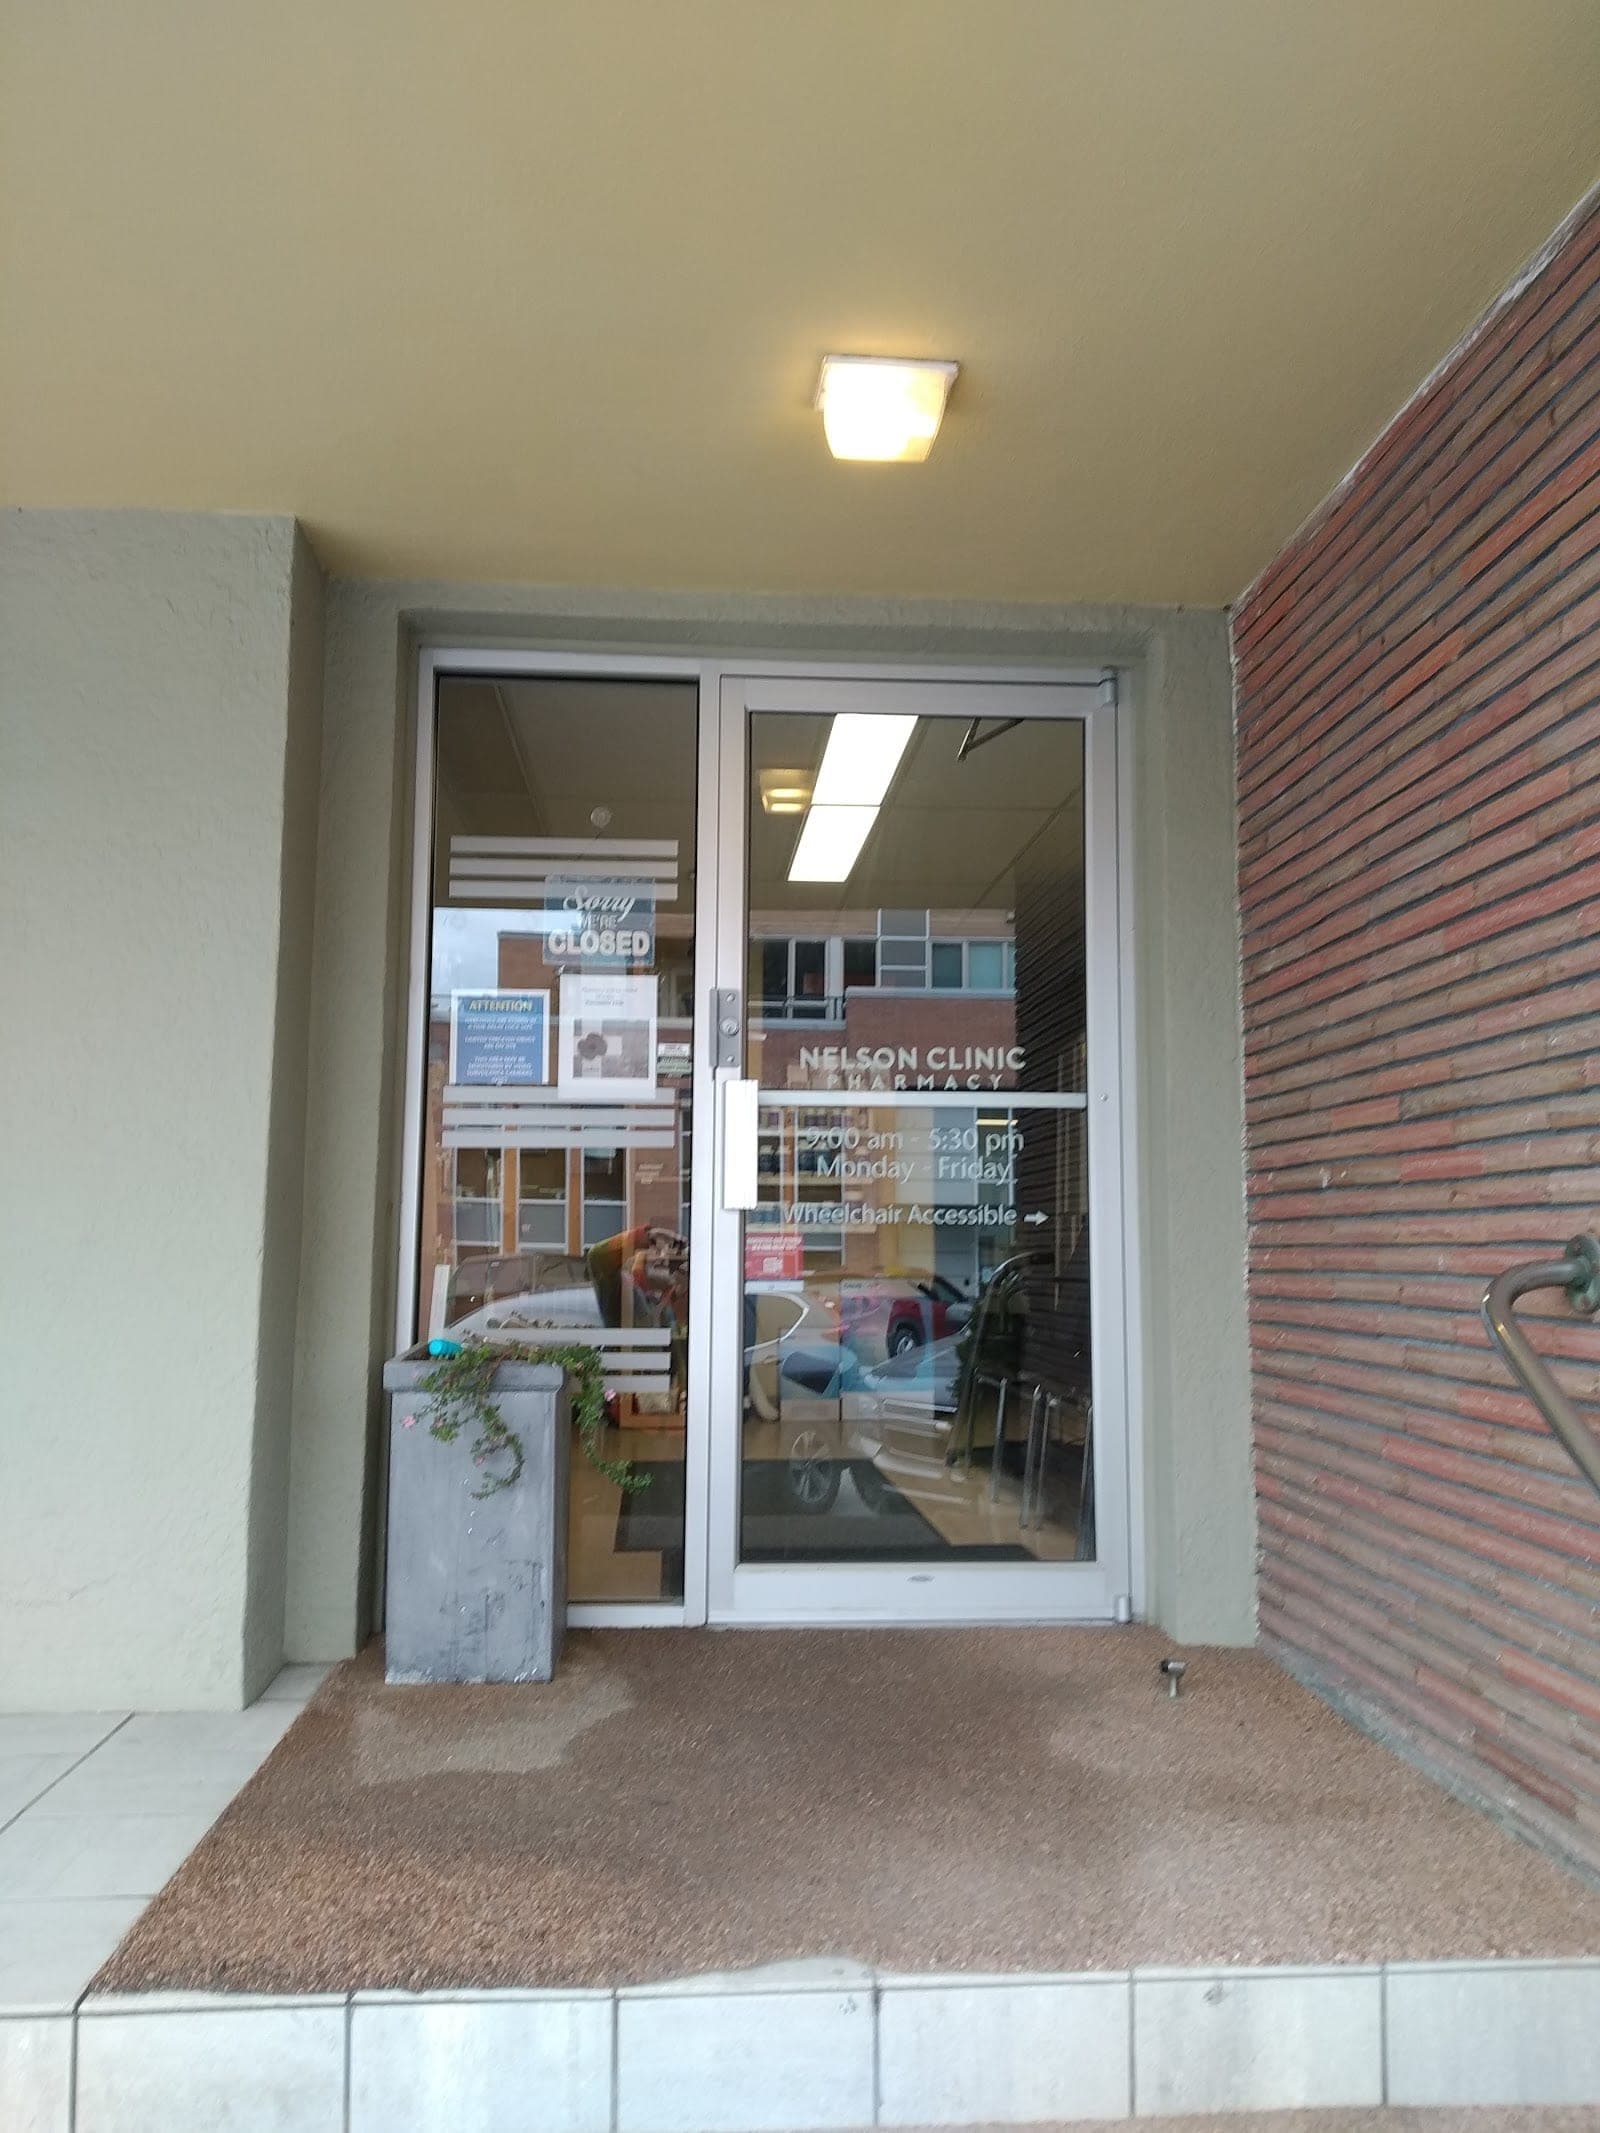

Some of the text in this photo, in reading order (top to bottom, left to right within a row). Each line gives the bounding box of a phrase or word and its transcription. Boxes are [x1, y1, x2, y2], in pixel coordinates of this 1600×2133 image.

[563, 885, 635, 923] Sorry
[548, 930, 650, 957] CLOSED
[469, 999, 533, 1012] ATTENTION
[800, 1046, 1026, 1070] NELSON CLINIC
[826, 1073, 1003, 1091] PHARMACY
[806, 1127, 860, 1149] 9:00
[867, 1132, 904, 1150] am
[928, 1127, 977, 1150] 5:30
[985, 1132, 1024, 1157] pm
[817, 1155, 915, 1184] Monday
[938, 1156, 1012, 1186] Friday
[782, 1203, 1018, 1226] Wheelchair Accessible
